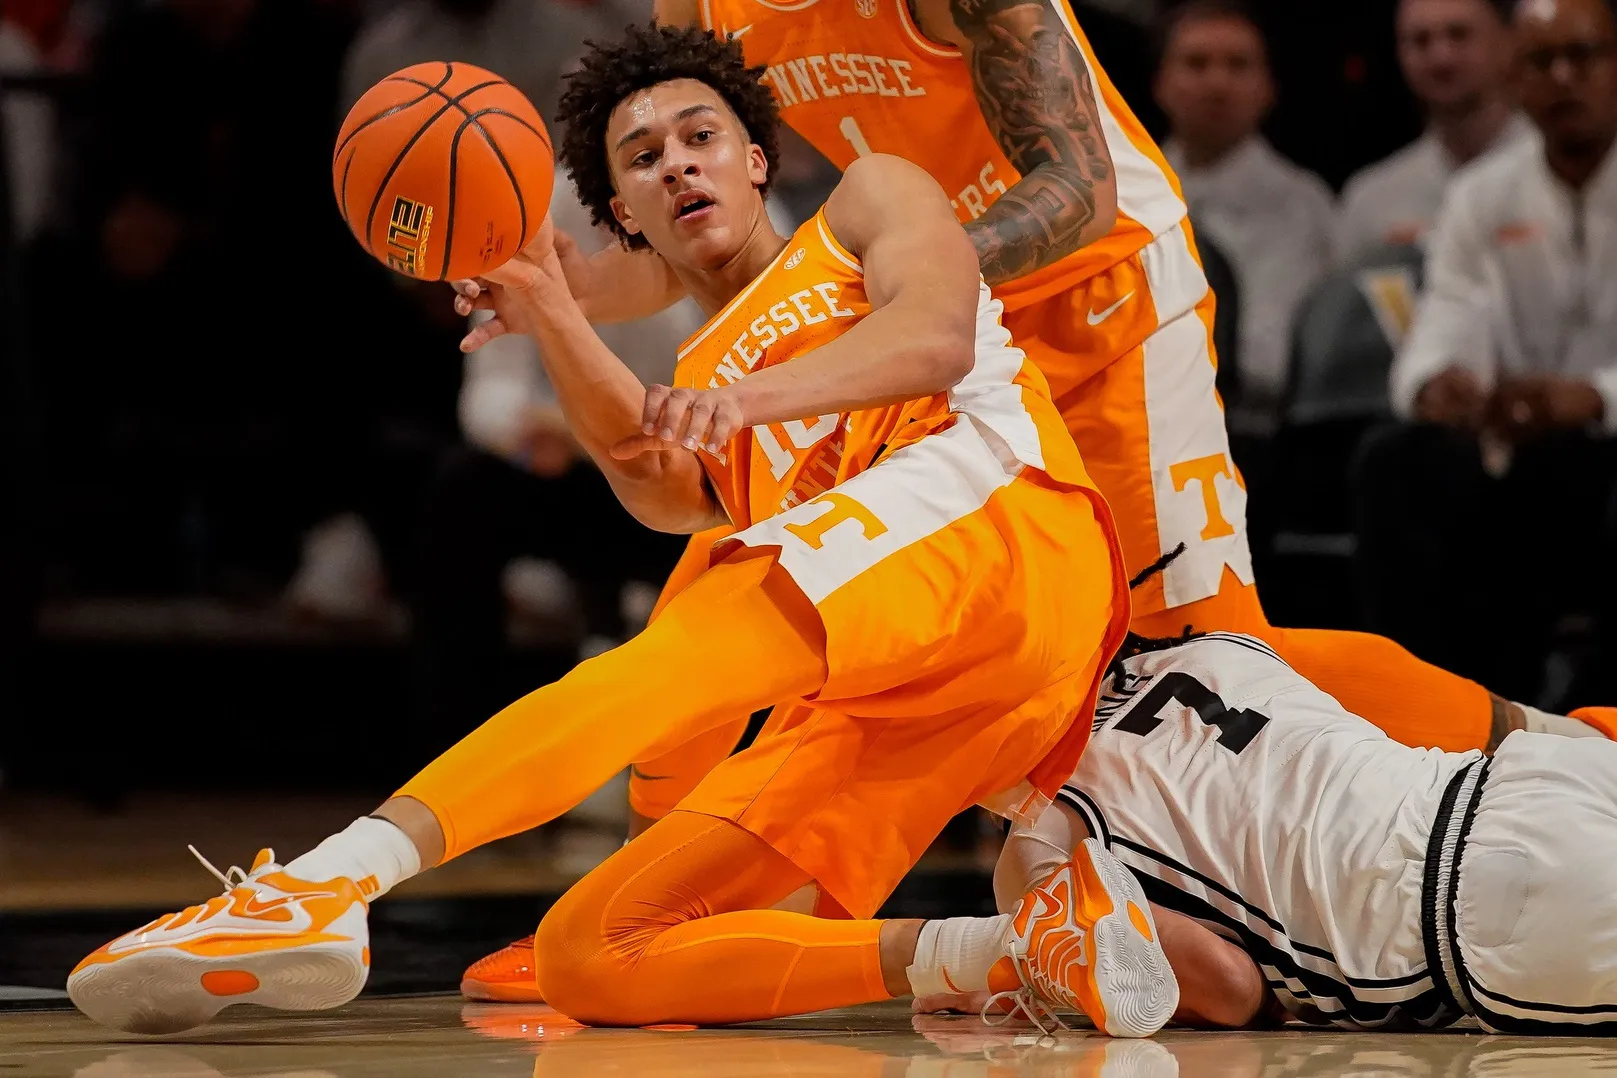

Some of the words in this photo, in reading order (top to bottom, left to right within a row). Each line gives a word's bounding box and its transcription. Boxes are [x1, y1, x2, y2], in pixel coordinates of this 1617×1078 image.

[758, 53, 926, 107] NNESSEE
[707, 282, 855, 390] NESSEE
[1169, 453, 1235, 541] T
[1112, 672, 1270, 755] 7
